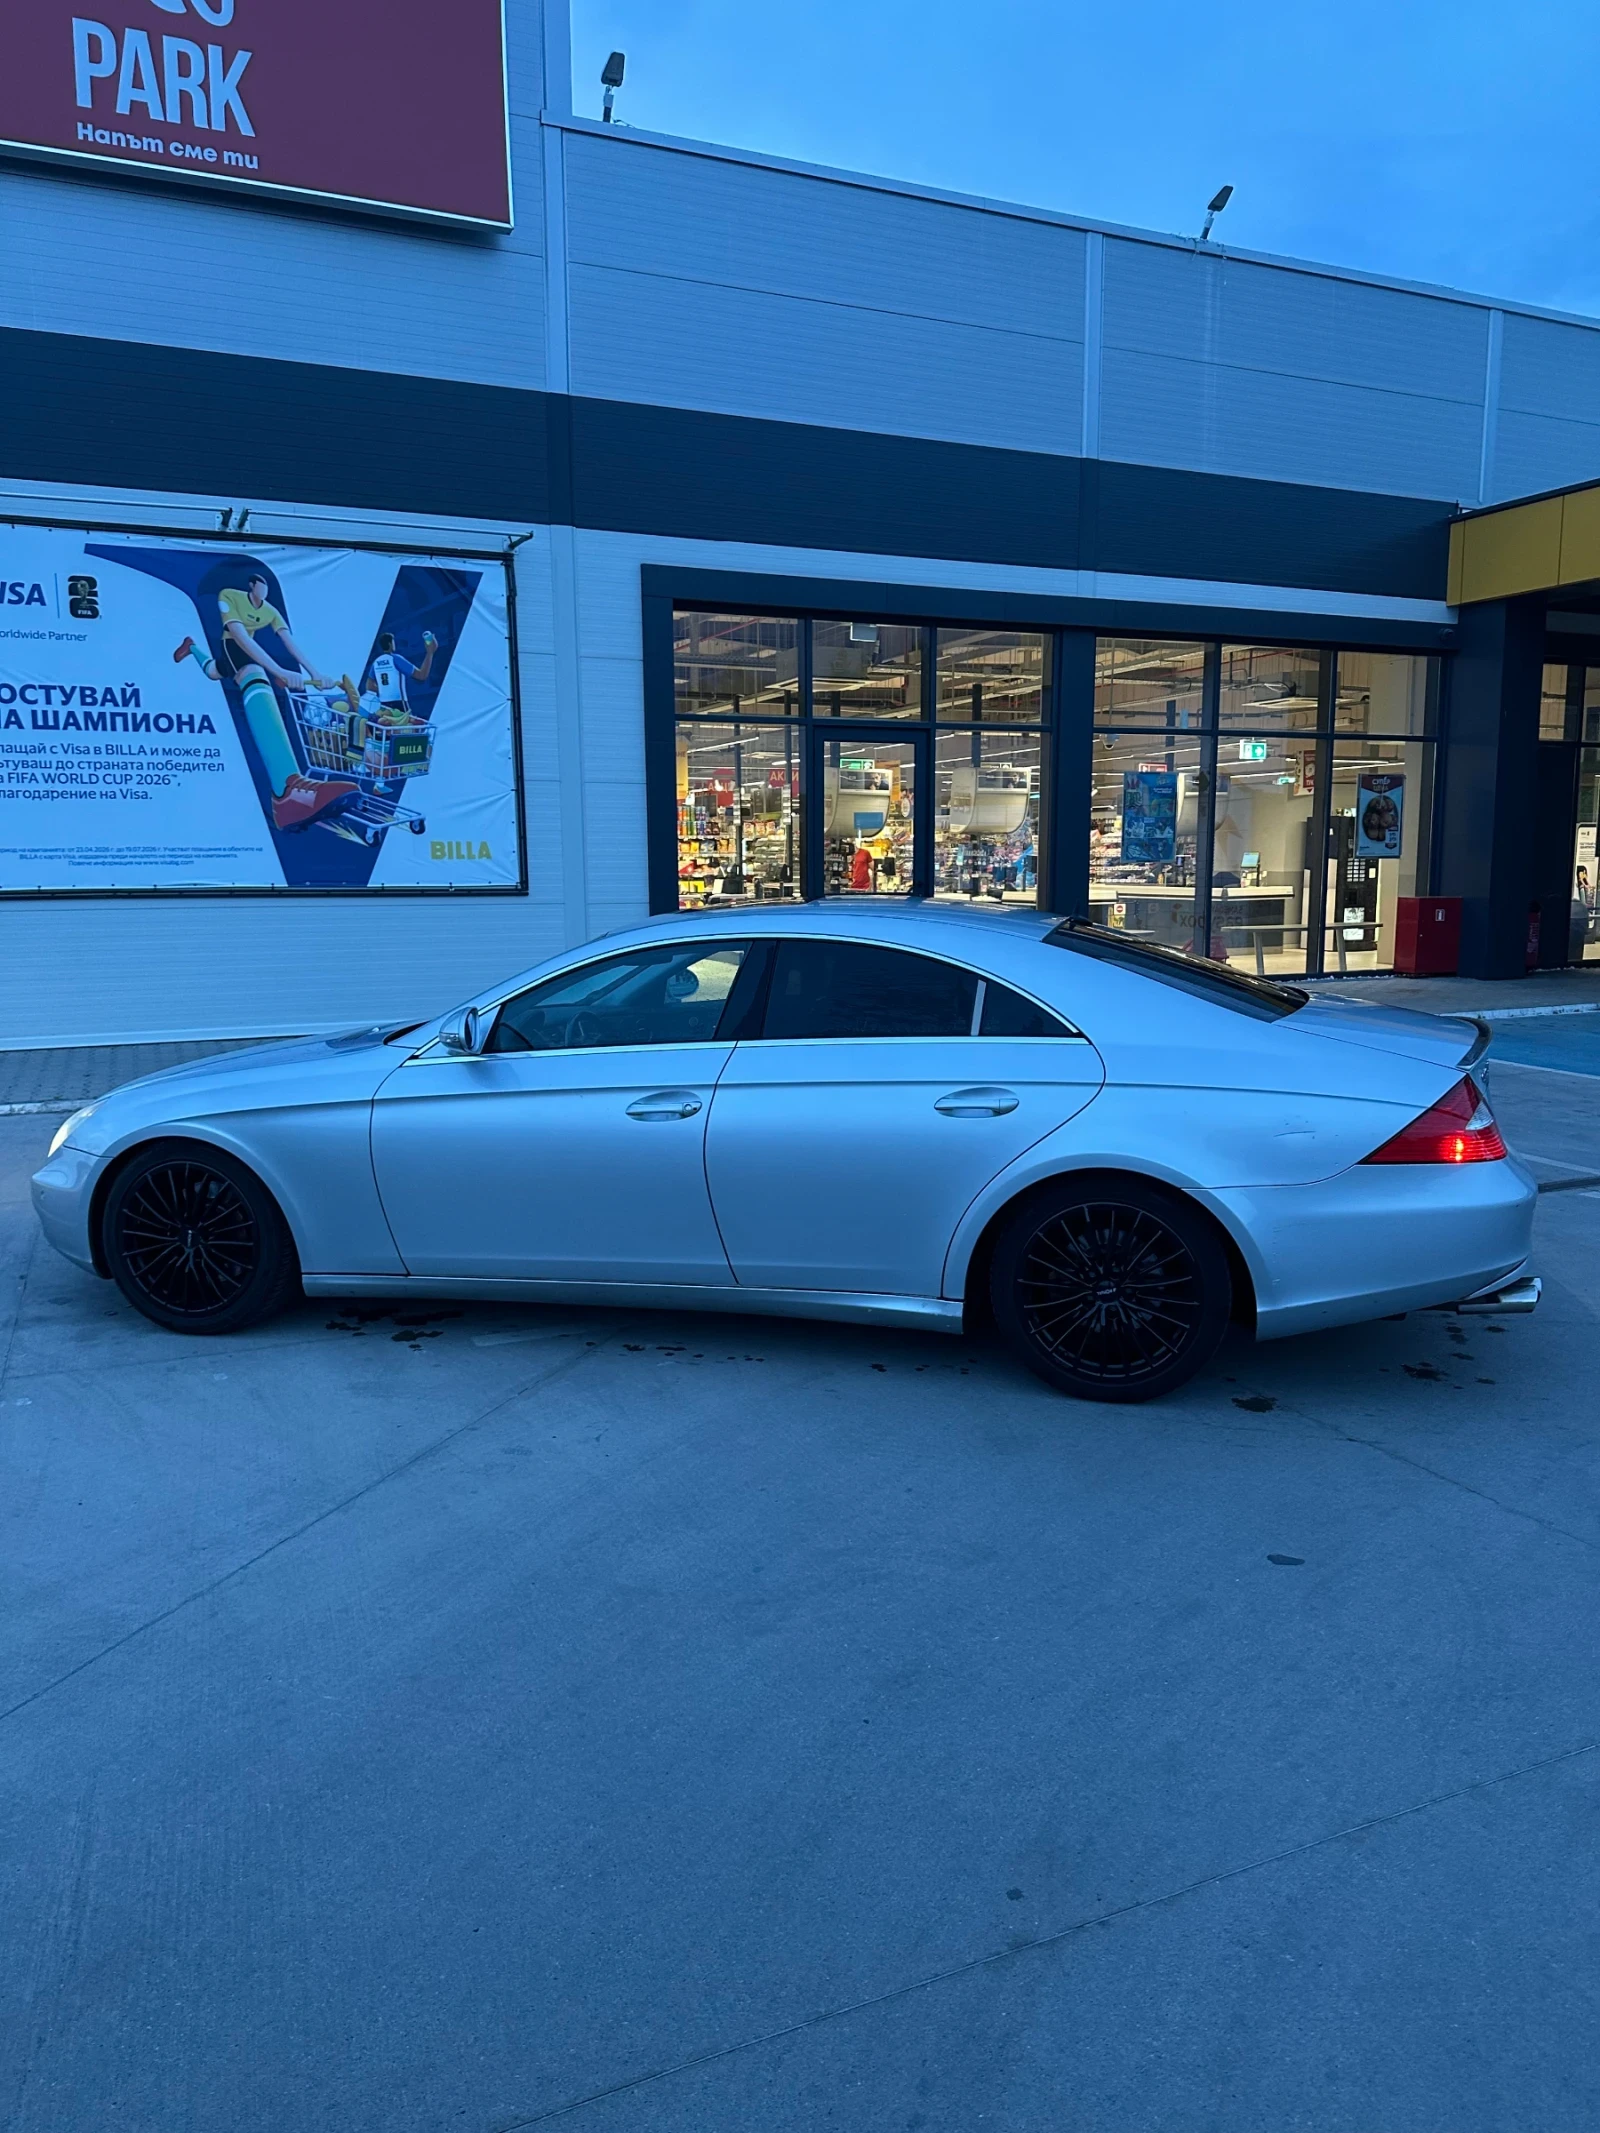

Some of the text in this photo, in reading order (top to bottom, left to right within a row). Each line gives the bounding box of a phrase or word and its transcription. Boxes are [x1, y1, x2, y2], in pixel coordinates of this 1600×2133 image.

[71, 16, 256, 138] PARK
[76, 121, 259, 170] Напът сме ти
[0, 581, 47, 607] ISA
[48, 631, 88, 642] Partner
[0, 708, 217, 735] А ШАМПИОНА
[51, 745, 58, 755] с
[60, 743, 91, 756] Visa
[94, 746, 102, 755] в
[105, 744, 147, 756] BILLA
[150, 747, 159, 756] и
[162, 747, 201, 757] може
[204, 747, 221, 759] да
[399, 745, 423, 755] BILLA
[56, 759, 74, 771] до
[77, 759, 144, 772] страната
[147, 758, 225, 773] победител
[8, 772, 40, 784] FIFA
[42, 773, 100, 785] WORLD
[103, 773, 134, 785] CUP
[100, 790, 117, 801] на
[119, 788, 153, 801] Visa.
[430, 840, 493, 861] BILLA
